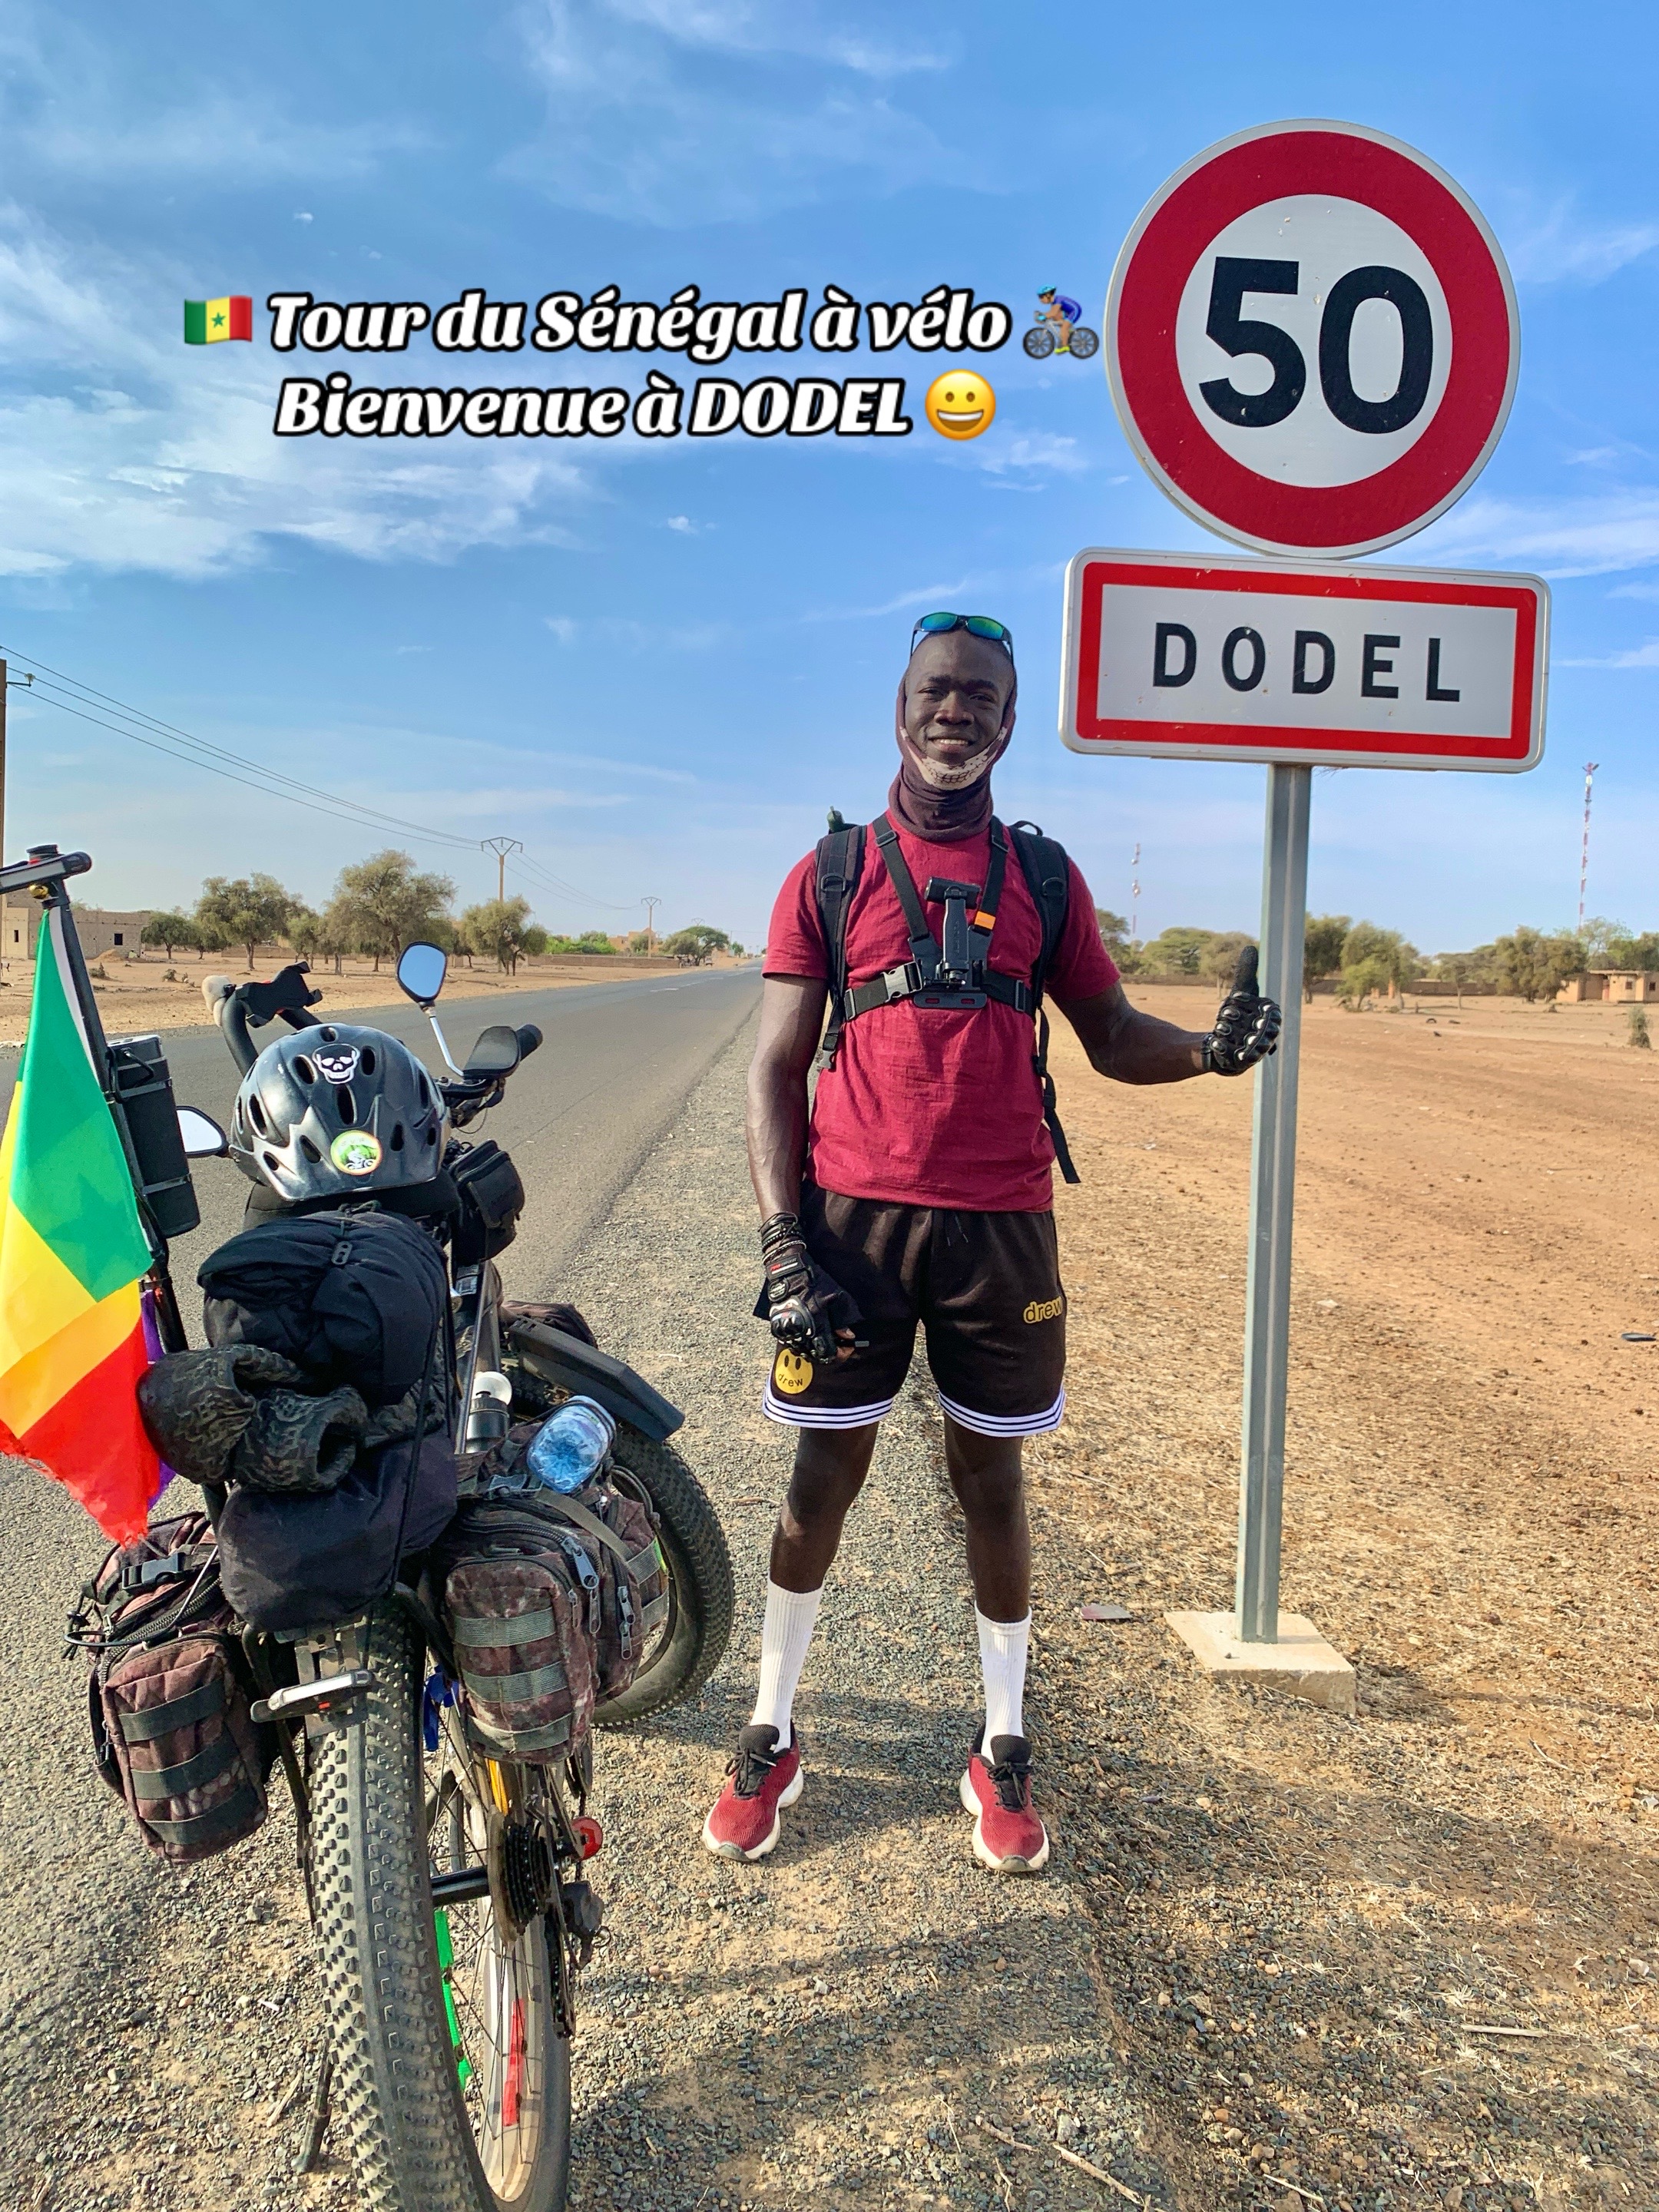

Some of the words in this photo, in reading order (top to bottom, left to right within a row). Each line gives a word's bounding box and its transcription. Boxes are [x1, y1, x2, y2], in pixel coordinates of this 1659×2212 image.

[1199, 256, 1433, 435] 50
[1153, 622, 1461, 703] DODEL
[1024, 1298, 1062, 1323] drew
[778, 1373, 803, 1387] drew
